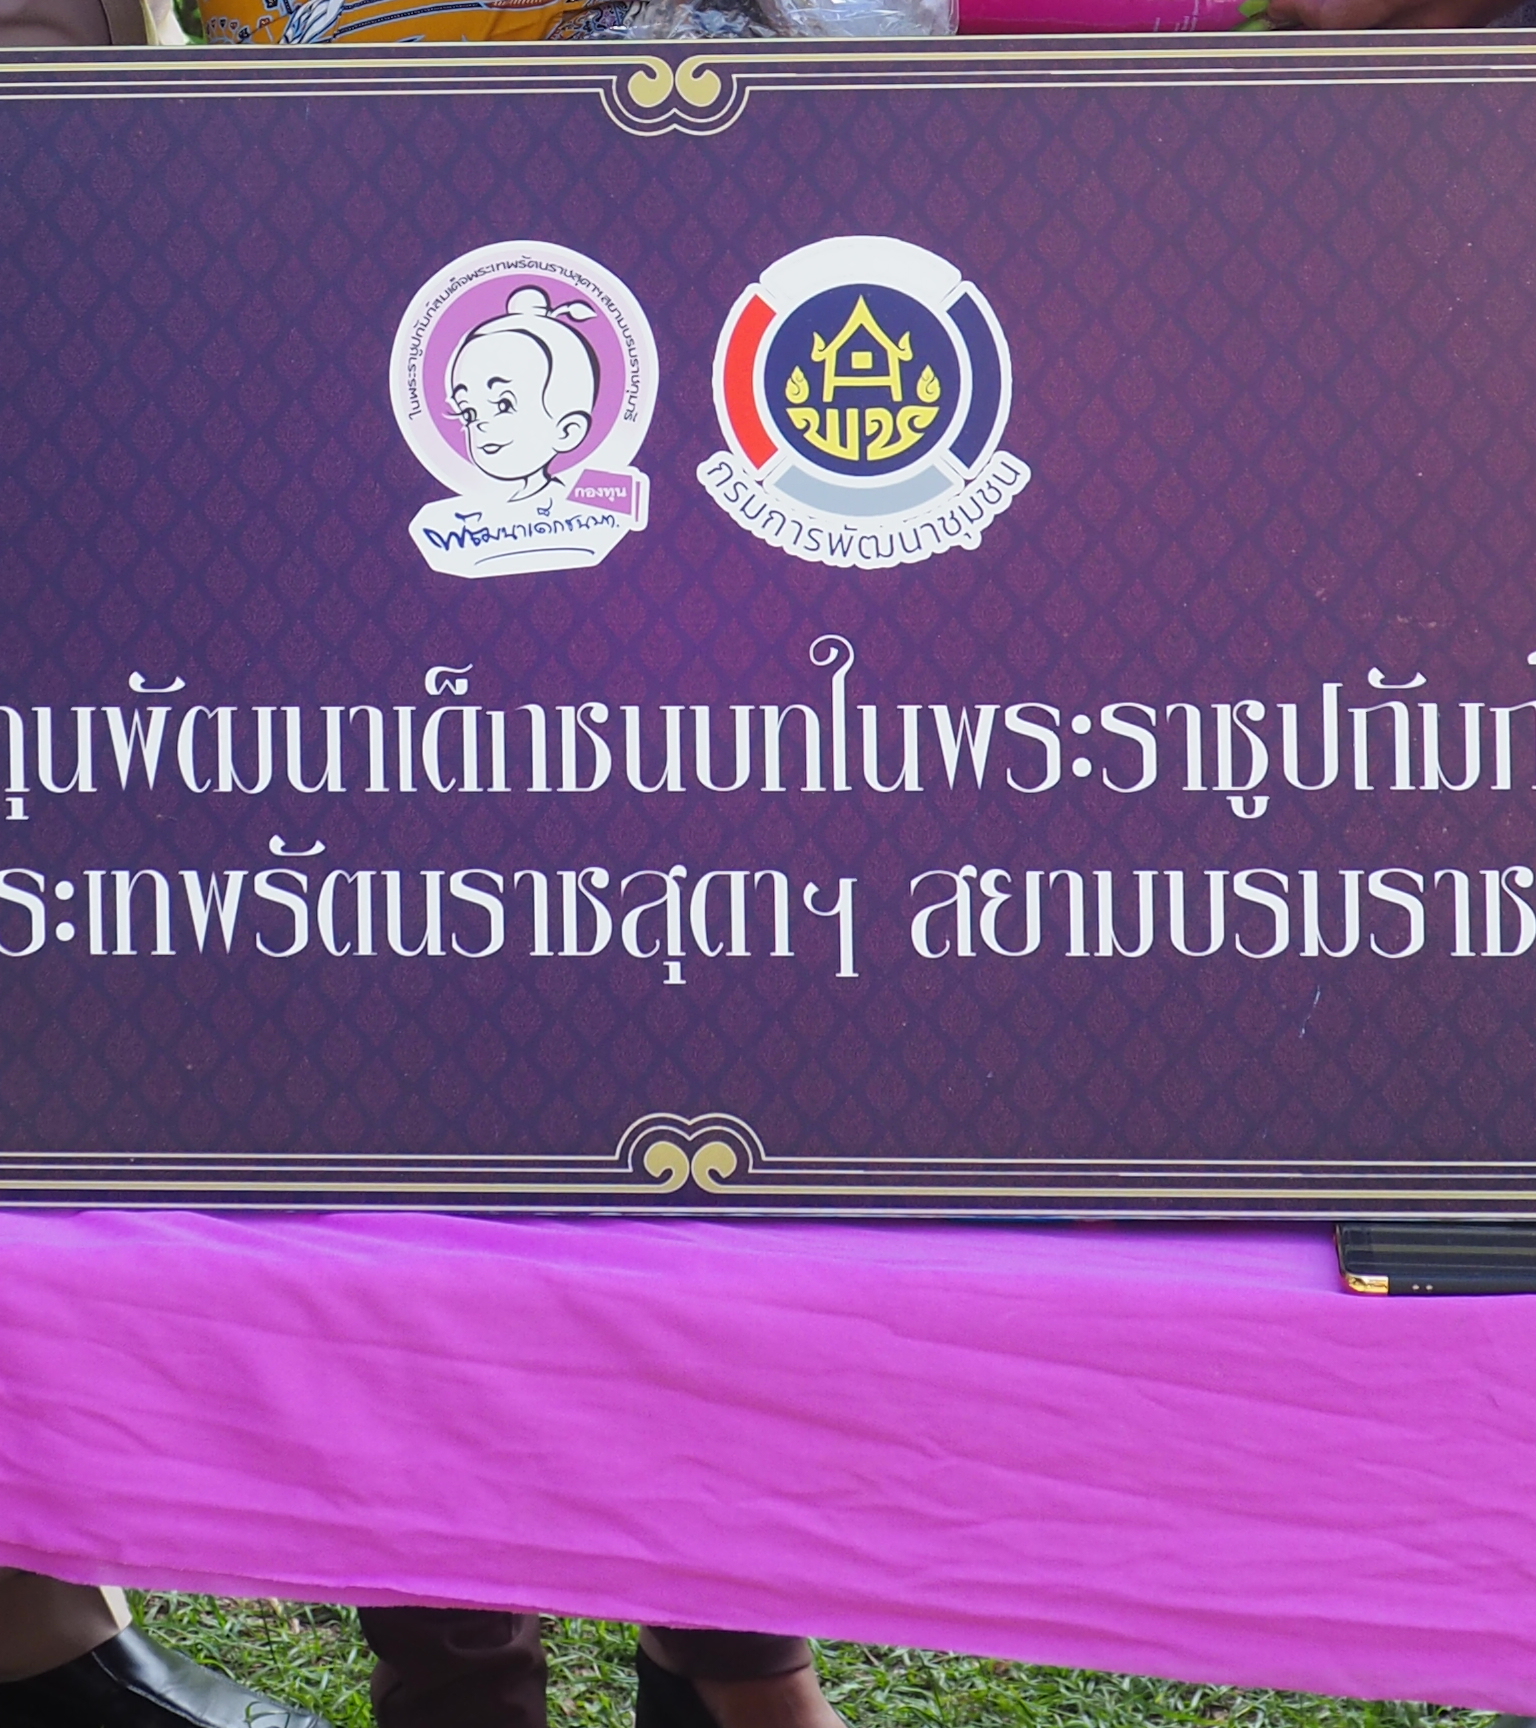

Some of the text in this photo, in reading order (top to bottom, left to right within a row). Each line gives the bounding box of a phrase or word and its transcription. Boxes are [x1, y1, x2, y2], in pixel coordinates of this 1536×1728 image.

[573, 484, 629, 503] กองทุน
[706, 459, 1022, 561] กรมการพัฒนาชุมชน
